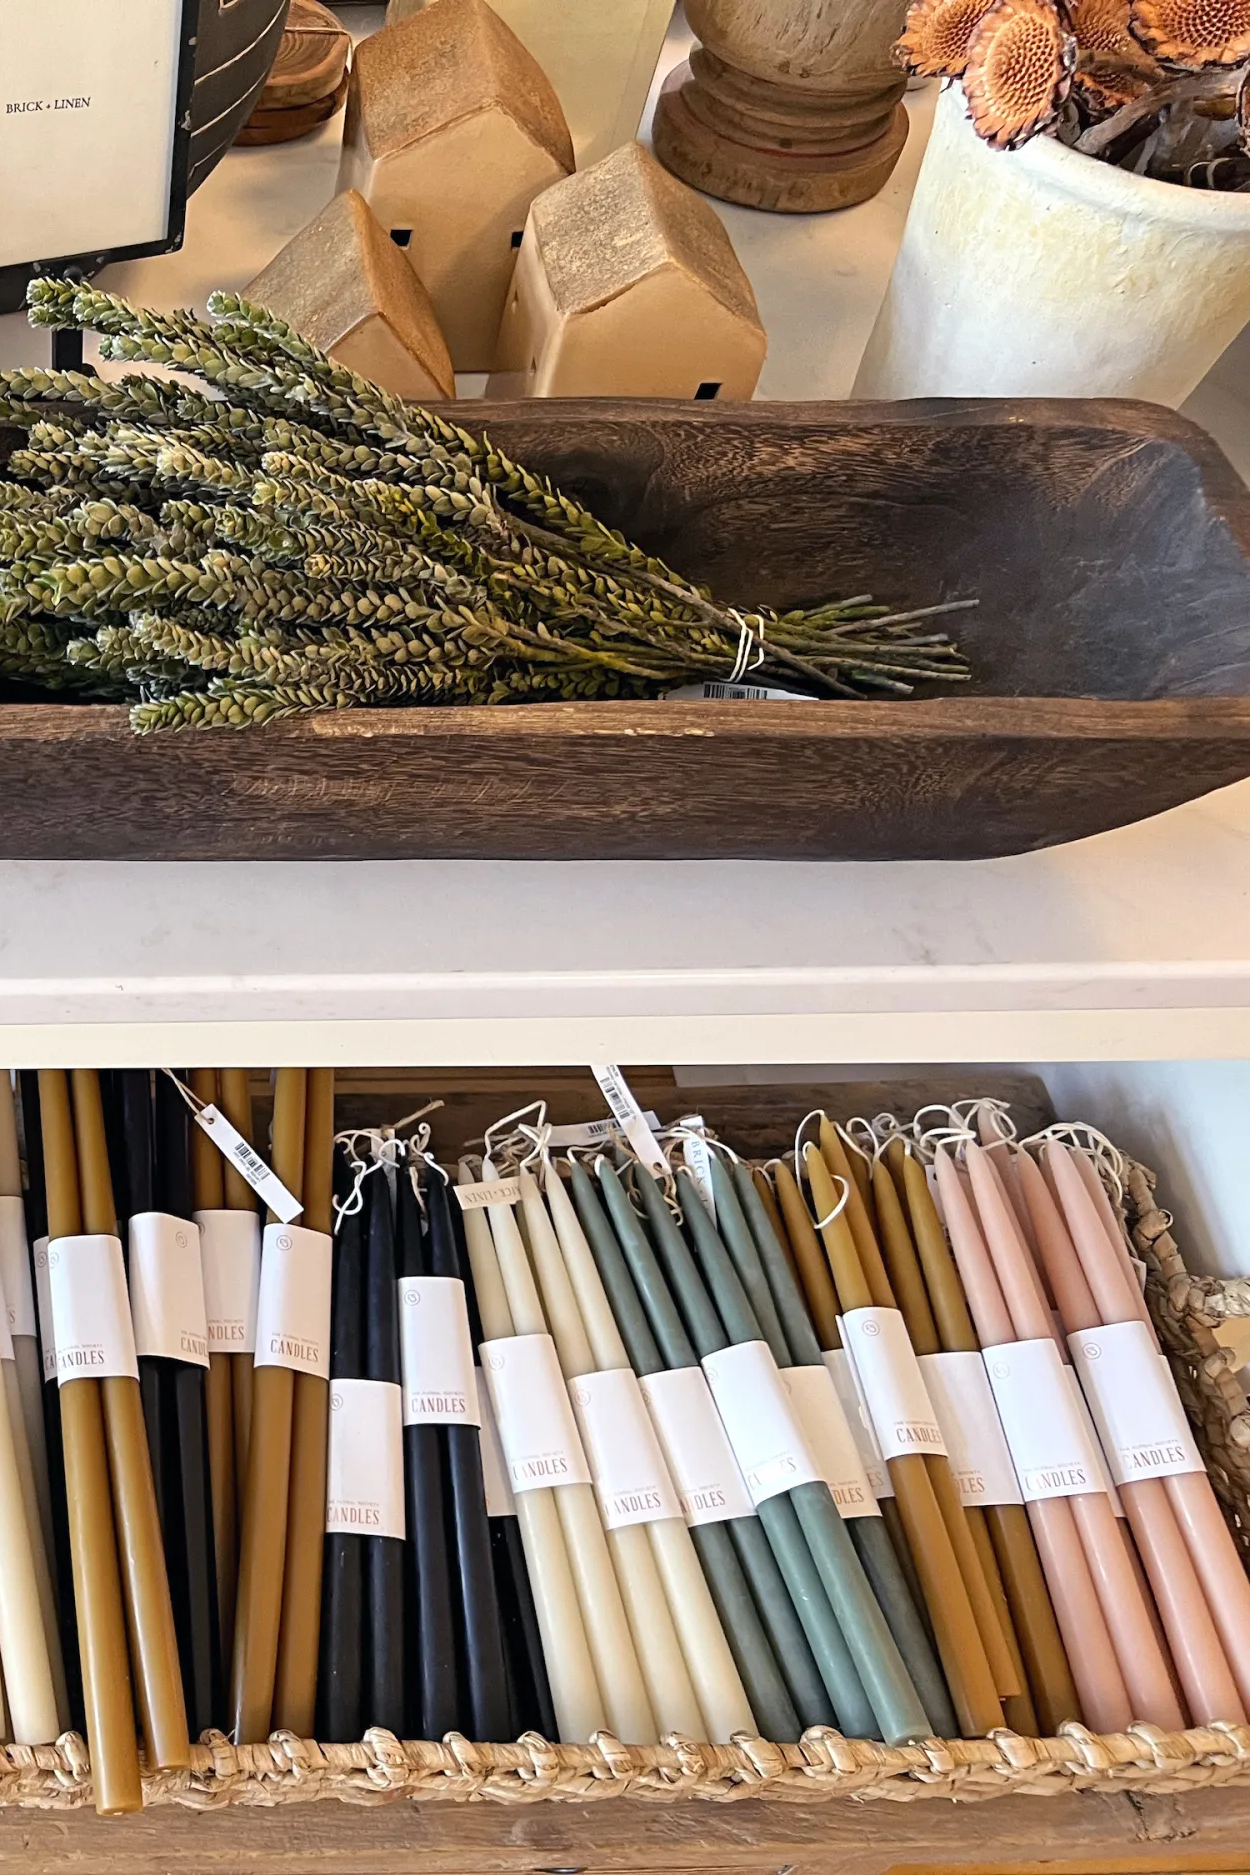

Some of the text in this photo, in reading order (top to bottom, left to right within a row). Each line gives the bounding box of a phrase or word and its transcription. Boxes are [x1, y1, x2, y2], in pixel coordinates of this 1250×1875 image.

[6, 100, 43, 114] BRICK
[54, 97, 92, 110] LINEN
[499, 1185, 520, 1198] RICK
[208, 1326, 244, 1340] NDLES
[180, 1336, 208, 1358] CANDL
[270, 1338, 319, 1362] CANDLES
[411, 1398, 466, 1413] CANDLES
[1122, 1446, 1185, 1469] CANDLES
[834, 1487, 864, 1504] DLES
[326, 1507, 380, 1525] CANDLES
